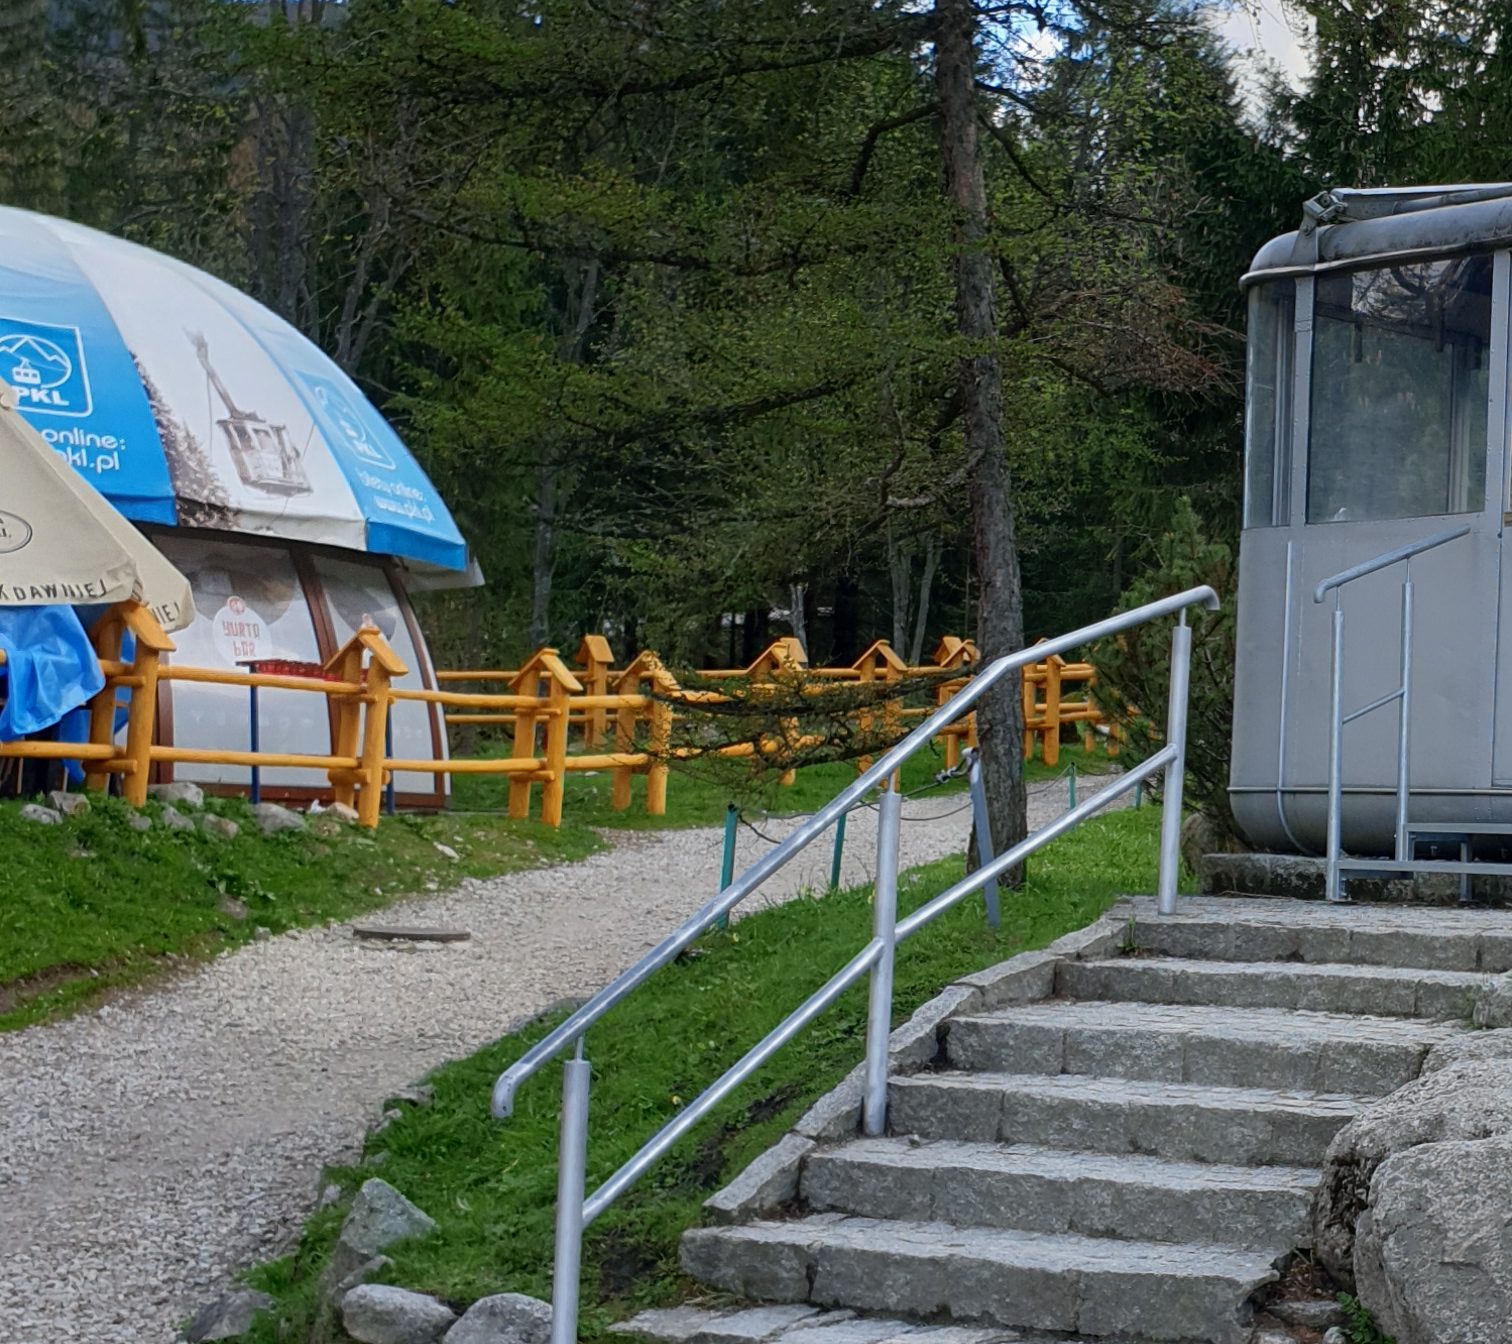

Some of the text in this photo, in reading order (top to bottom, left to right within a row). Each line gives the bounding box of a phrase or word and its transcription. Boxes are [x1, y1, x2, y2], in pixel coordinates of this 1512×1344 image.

[12, 385, 70, 406] PKL
[41, 427, 126, 451] online:
[13, 578, 107, 601] DAWNIEJ
